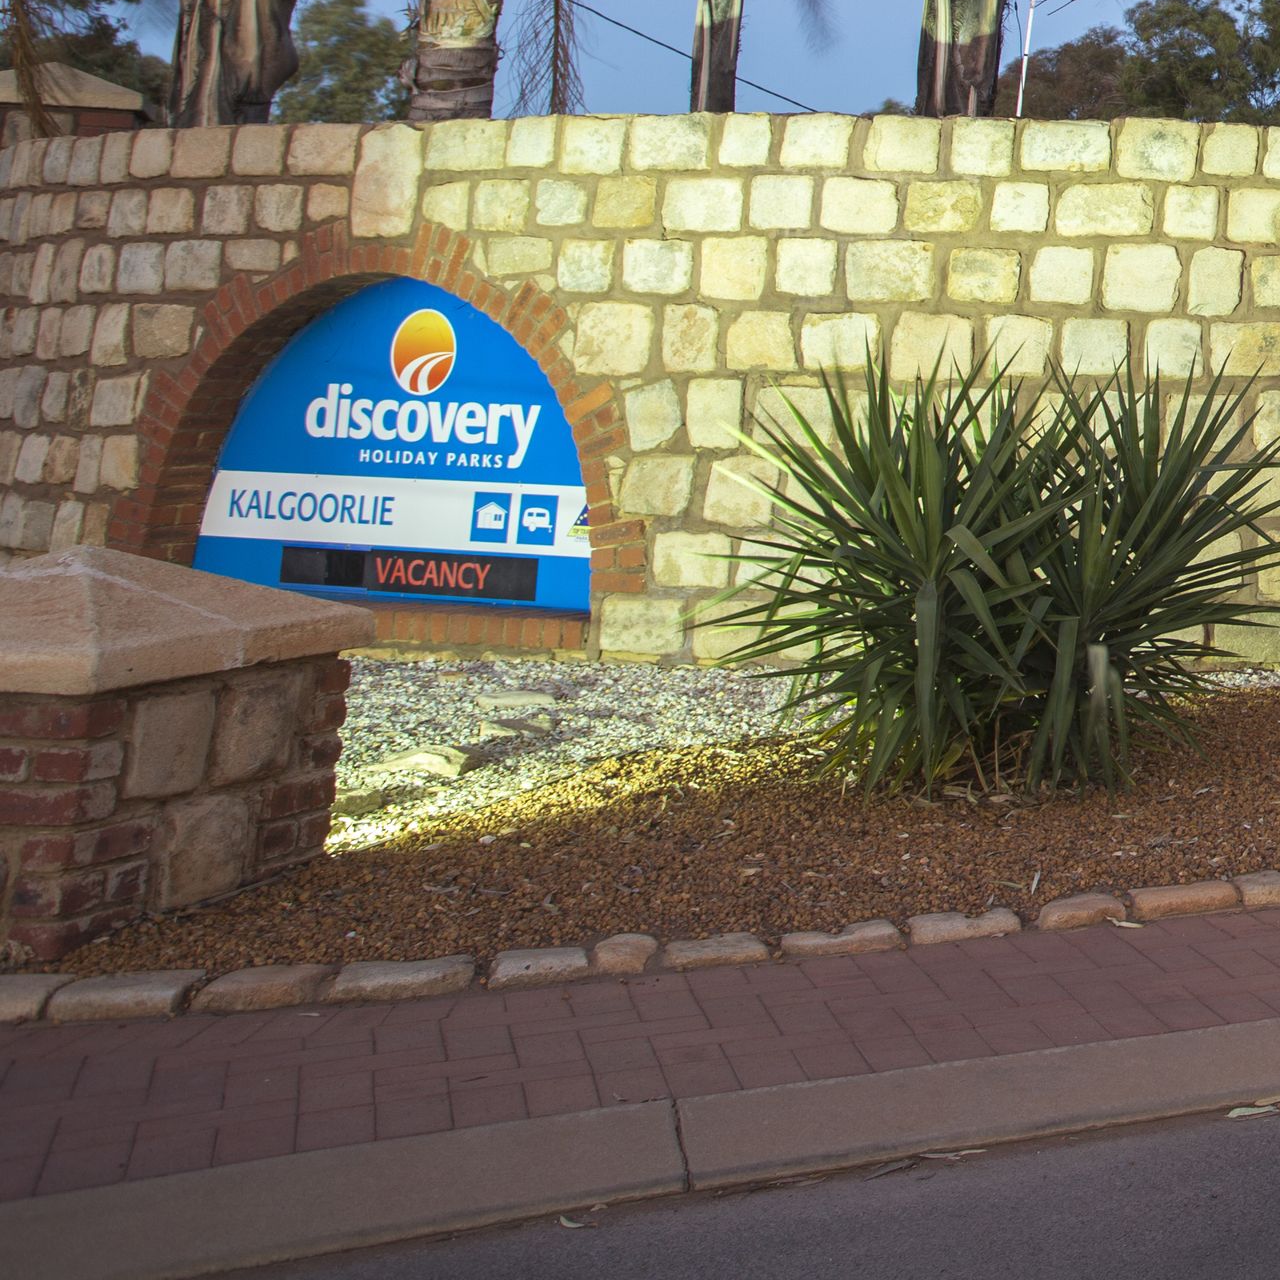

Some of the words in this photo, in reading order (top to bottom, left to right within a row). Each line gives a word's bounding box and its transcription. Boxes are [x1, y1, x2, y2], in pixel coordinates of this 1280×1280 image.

[305, 383, 541, 469] discovery
[359, 449, 439, 466] HOLIDAY
[446, 453, 503, 469] PARKS
[228, 489, 396, 526] KALGOORLIE
[375, 557, 491, 590] VACANCY
